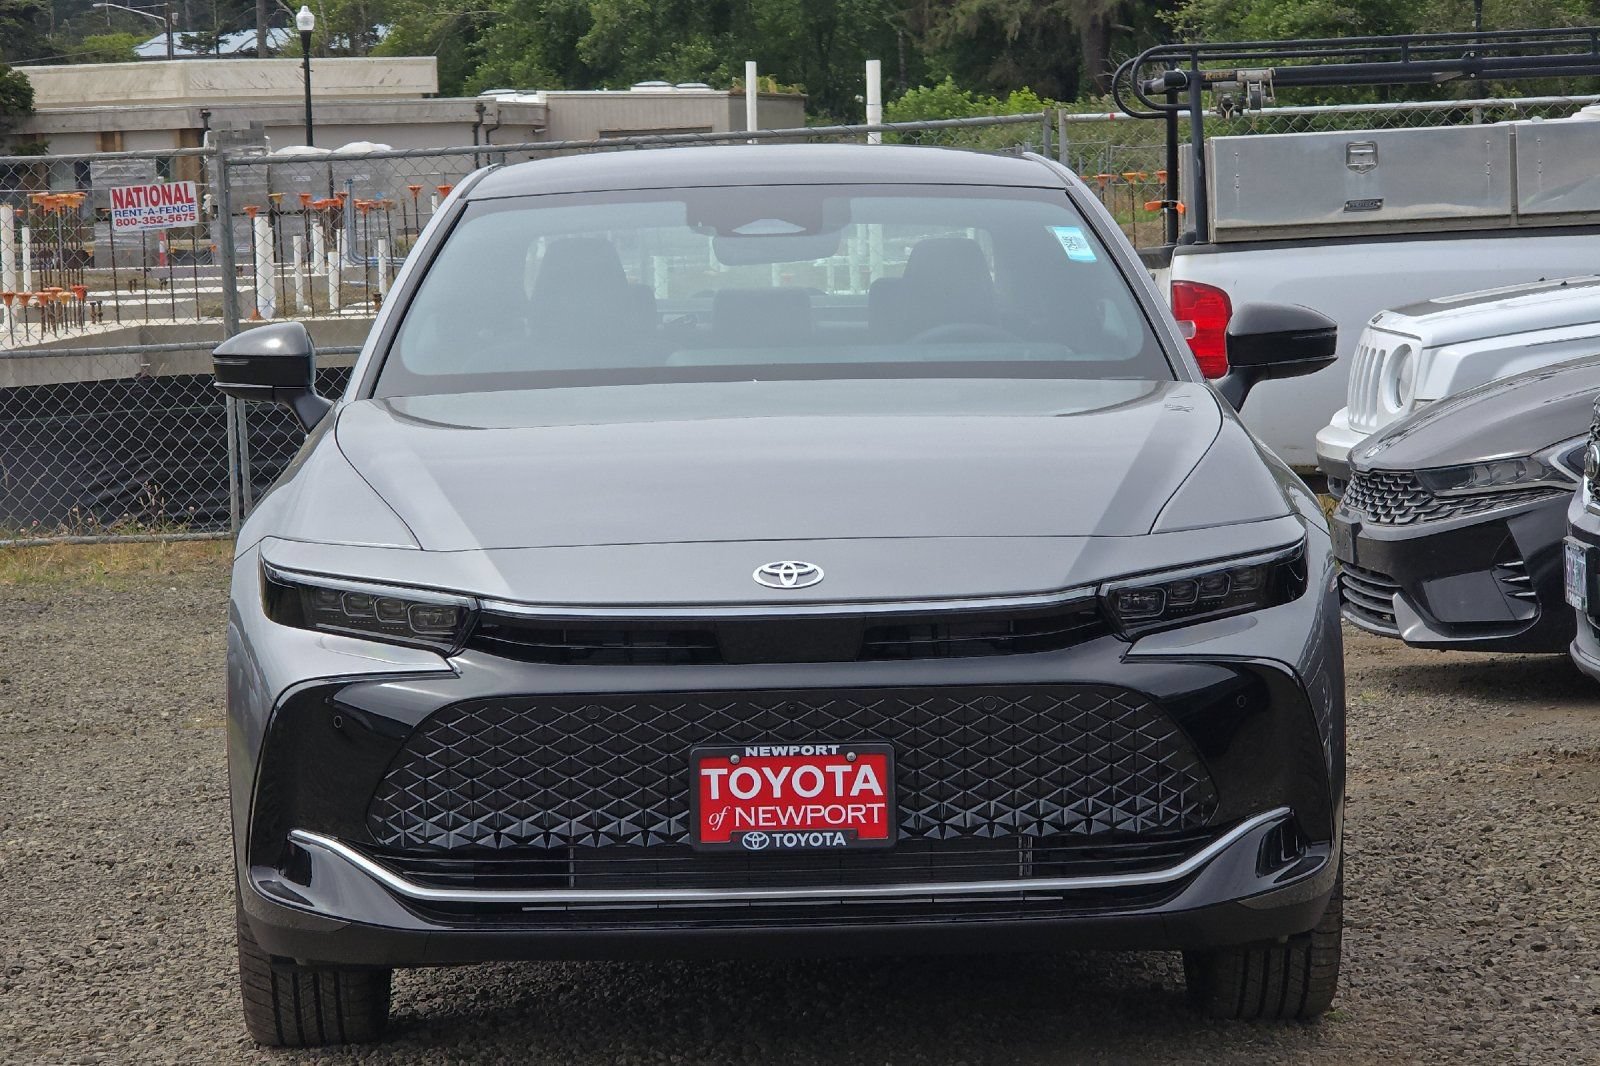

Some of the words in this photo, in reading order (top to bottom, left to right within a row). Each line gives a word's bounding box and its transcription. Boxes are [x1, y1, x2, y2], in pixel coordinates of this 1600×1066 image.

[112, 183, 194, 209] NATIONAL
[115, 204, 195, 218] RENT-A-FENCE
[116, 213, 195, 227] 800-352-5675
[745, 744, 840, 757] NEWPORT
[701, 764, 884, 800] TOYOTA
[708, 806, 731, 831] of
[735, 803, 885, 827] NEWPORT
[772, 831, 846, 848] TOYOTA
